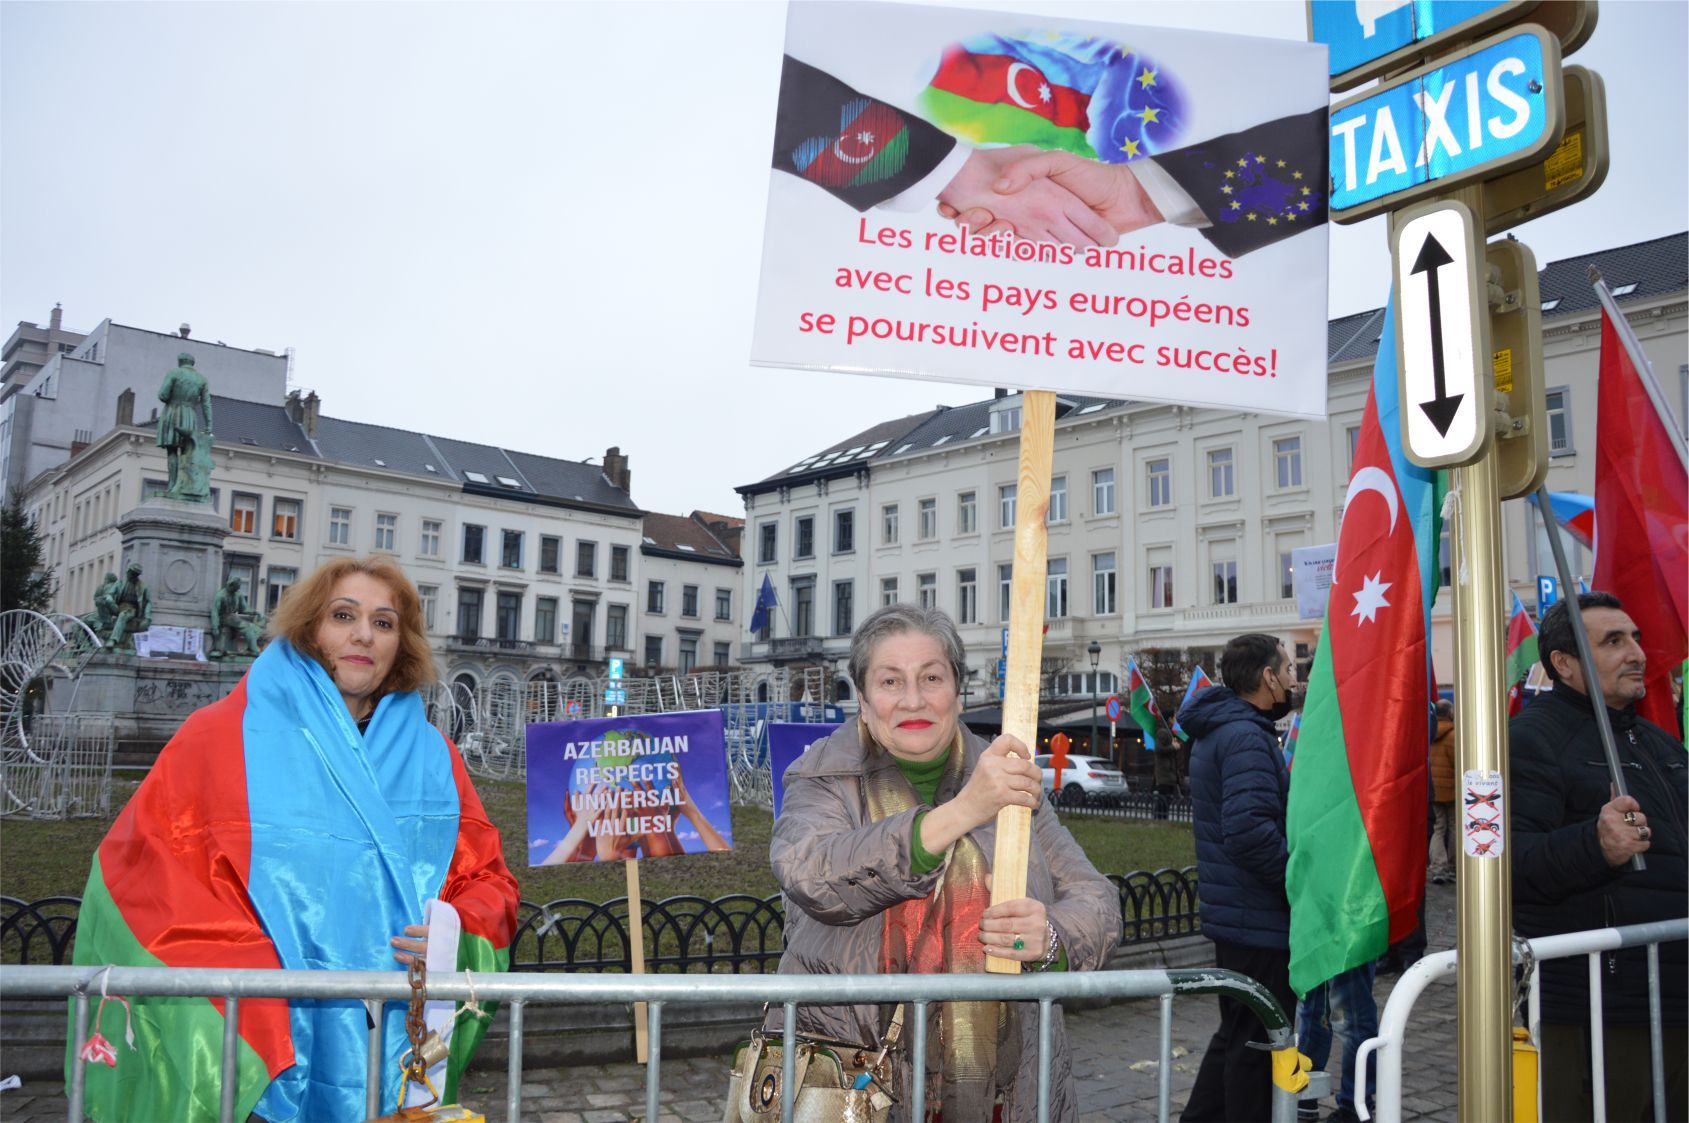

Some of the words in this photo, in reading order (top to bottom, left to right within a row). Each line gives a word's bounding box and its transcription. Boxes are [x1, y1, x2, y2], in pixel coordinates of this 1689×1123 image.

[1332, 57, 1531, 192] TAXIS
[858, 218, 913, 248] Les
[925, 225, 1074, 265] relations
[1085, 246, 1233, 279] amicales
[835, 268, 913, 295] avec
[925, 267, 971, 301] les
[982, 283, 1058, 316] pays
[1069, 292, 1250, 328] européens
[799, 311, 836, 335] se
[847, 315, 1057, 357] poursuivent
[1067, 338, 1145, 365] avec
[1156, 347, 1278, 378] succès!
[1541, 579, 1553, 602] P
[564, 735, 689, 760] AZERBAIJAN
[576, 762, 680, 785] RESPECTS
[571, 788, 687, 811] UNIVERSAL
[587, 815, 673, 838] VALUES!
